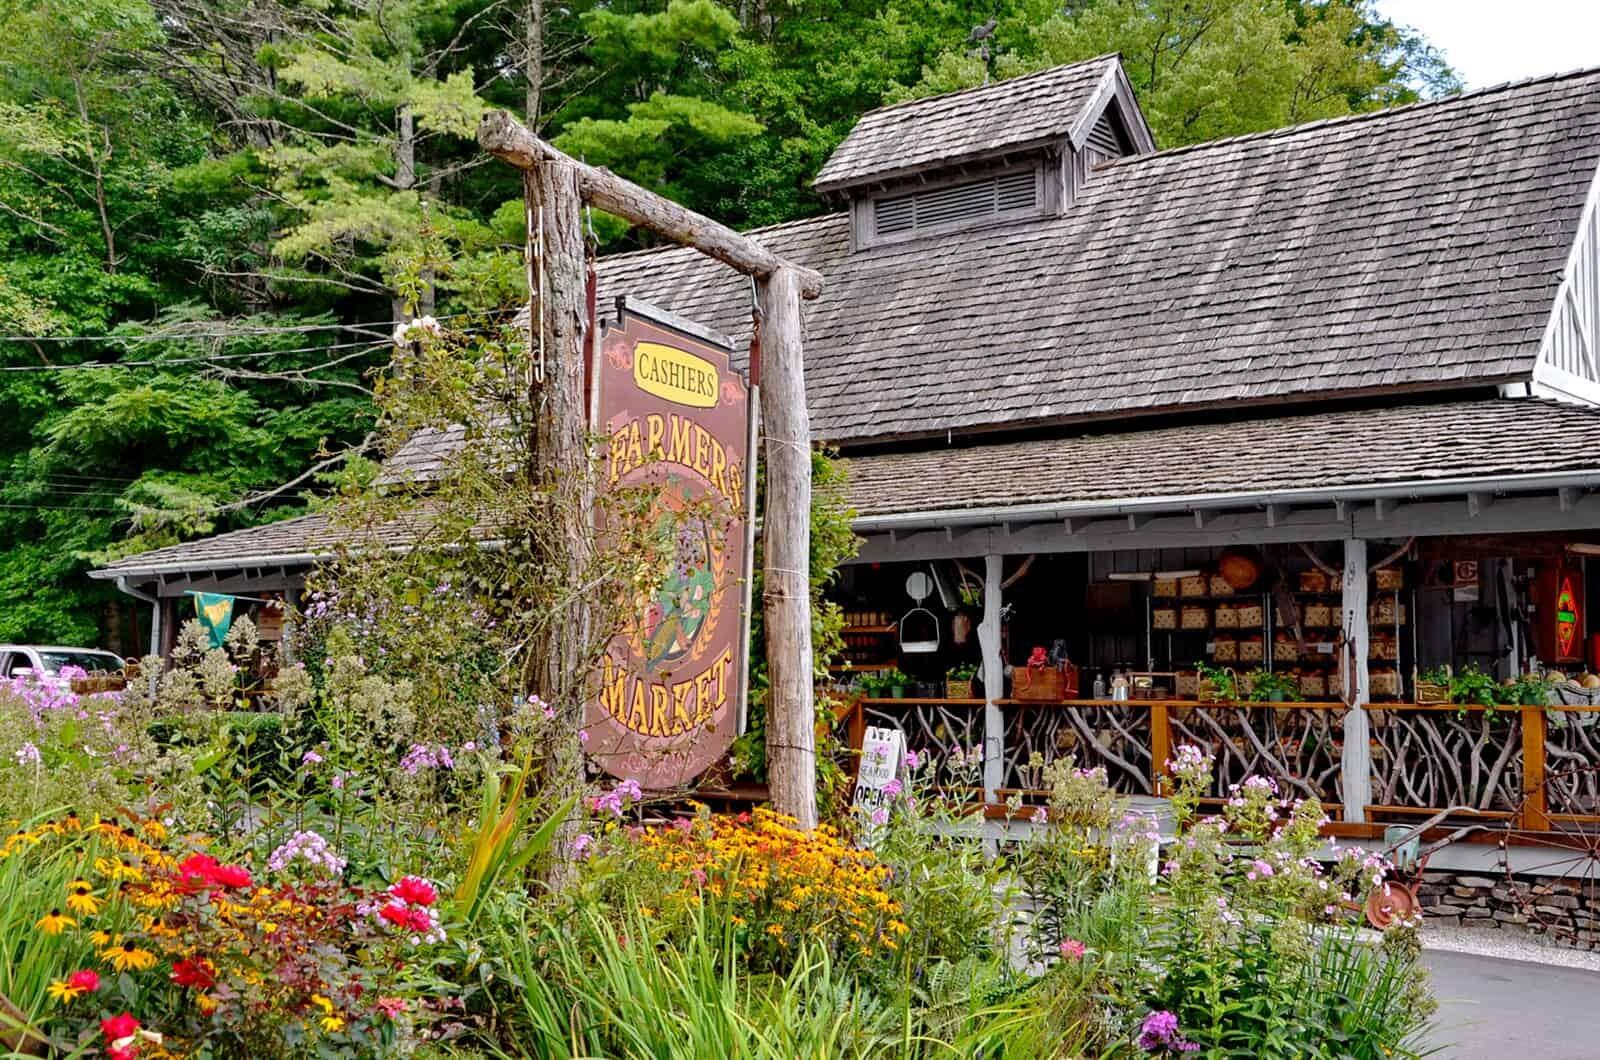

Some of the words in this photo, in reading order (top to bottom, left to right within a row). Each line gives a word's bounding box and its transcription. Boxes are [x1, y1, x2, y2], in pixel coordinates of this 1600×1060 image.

[638, 352, 714, 398] CASHIERS
[608, 413, 741, 508] FARMERS
[600, 648, 731, 737] MARKET
